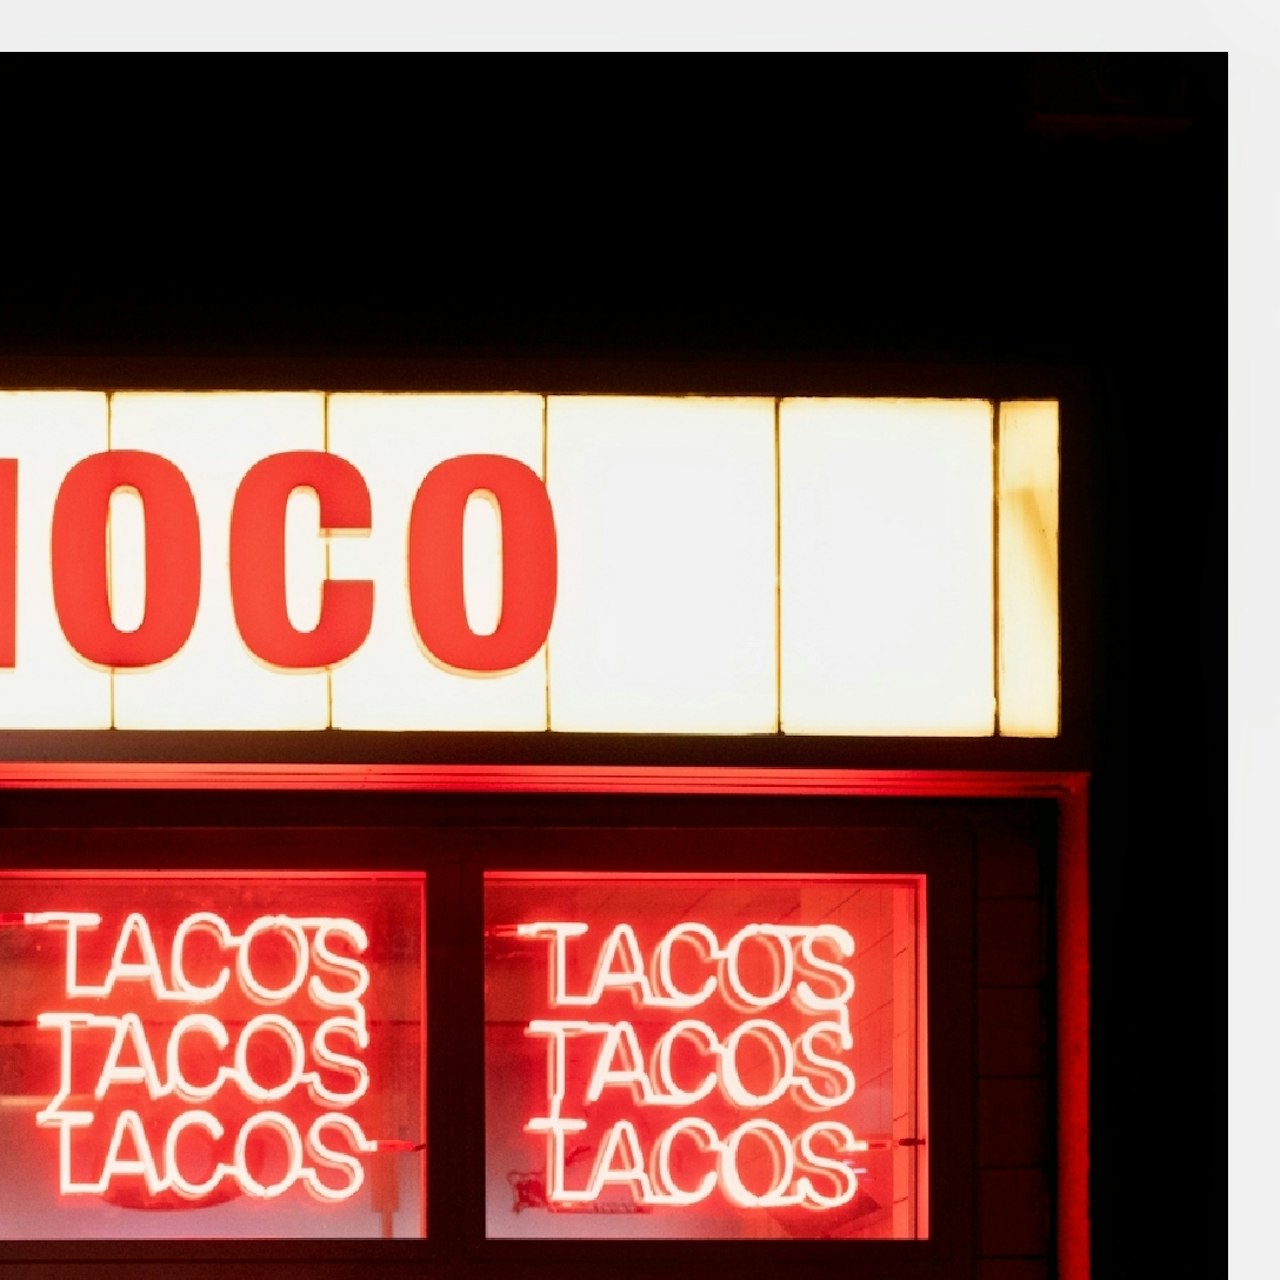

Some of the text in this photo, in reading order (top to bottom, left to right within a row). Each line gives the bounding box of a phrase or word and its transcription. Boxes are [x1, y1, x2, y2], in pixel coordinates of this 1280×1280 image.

[25, 912, 369, 1004] TACOS
[519, 922, 854, 1012] TACOS
[37, 1013, 369, 1106] TACOS
[527, 1020, 855, 1109] TACOS
[36, 1110, 377, 1200] TACOS
[527, 1117, 867, 1207] TACOS
